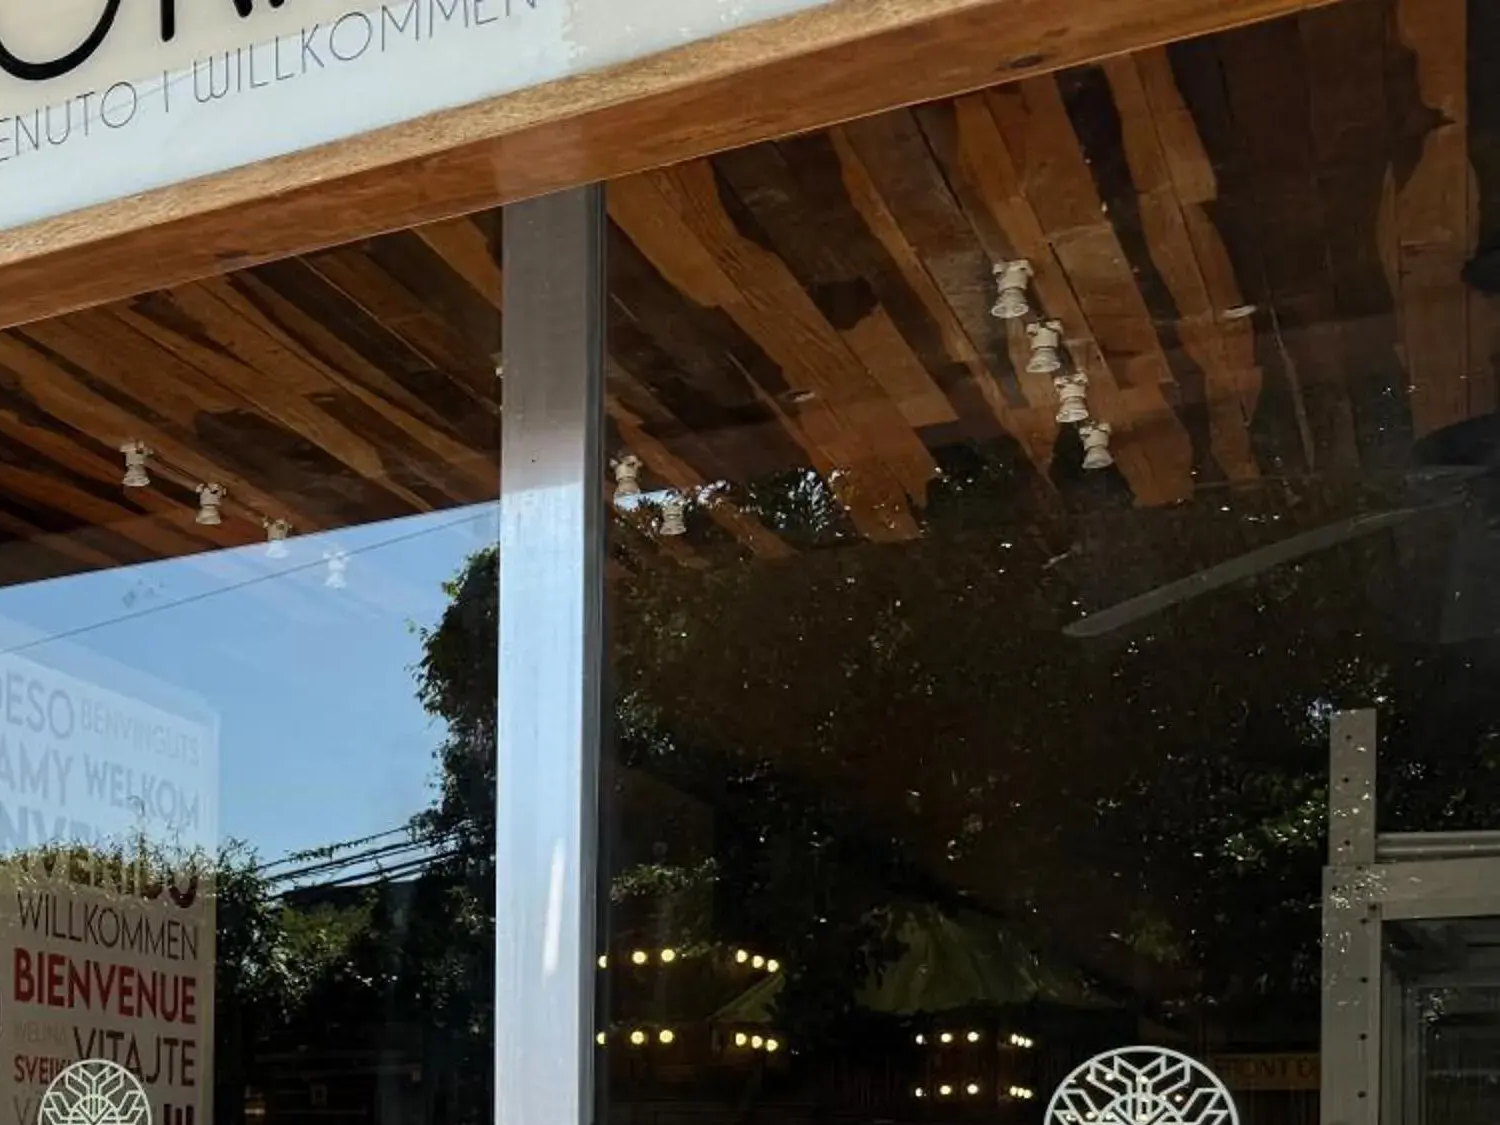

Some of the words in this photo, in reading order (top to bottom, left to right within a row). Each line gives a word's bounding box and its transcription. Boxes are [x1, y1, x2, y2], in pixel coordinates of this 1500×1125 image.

[83, 752, 199, 831] WELKOM
[17, 892, 198, 961] WILLKOMMEN
[13, 948, 197, 1024] BIENVENUE
